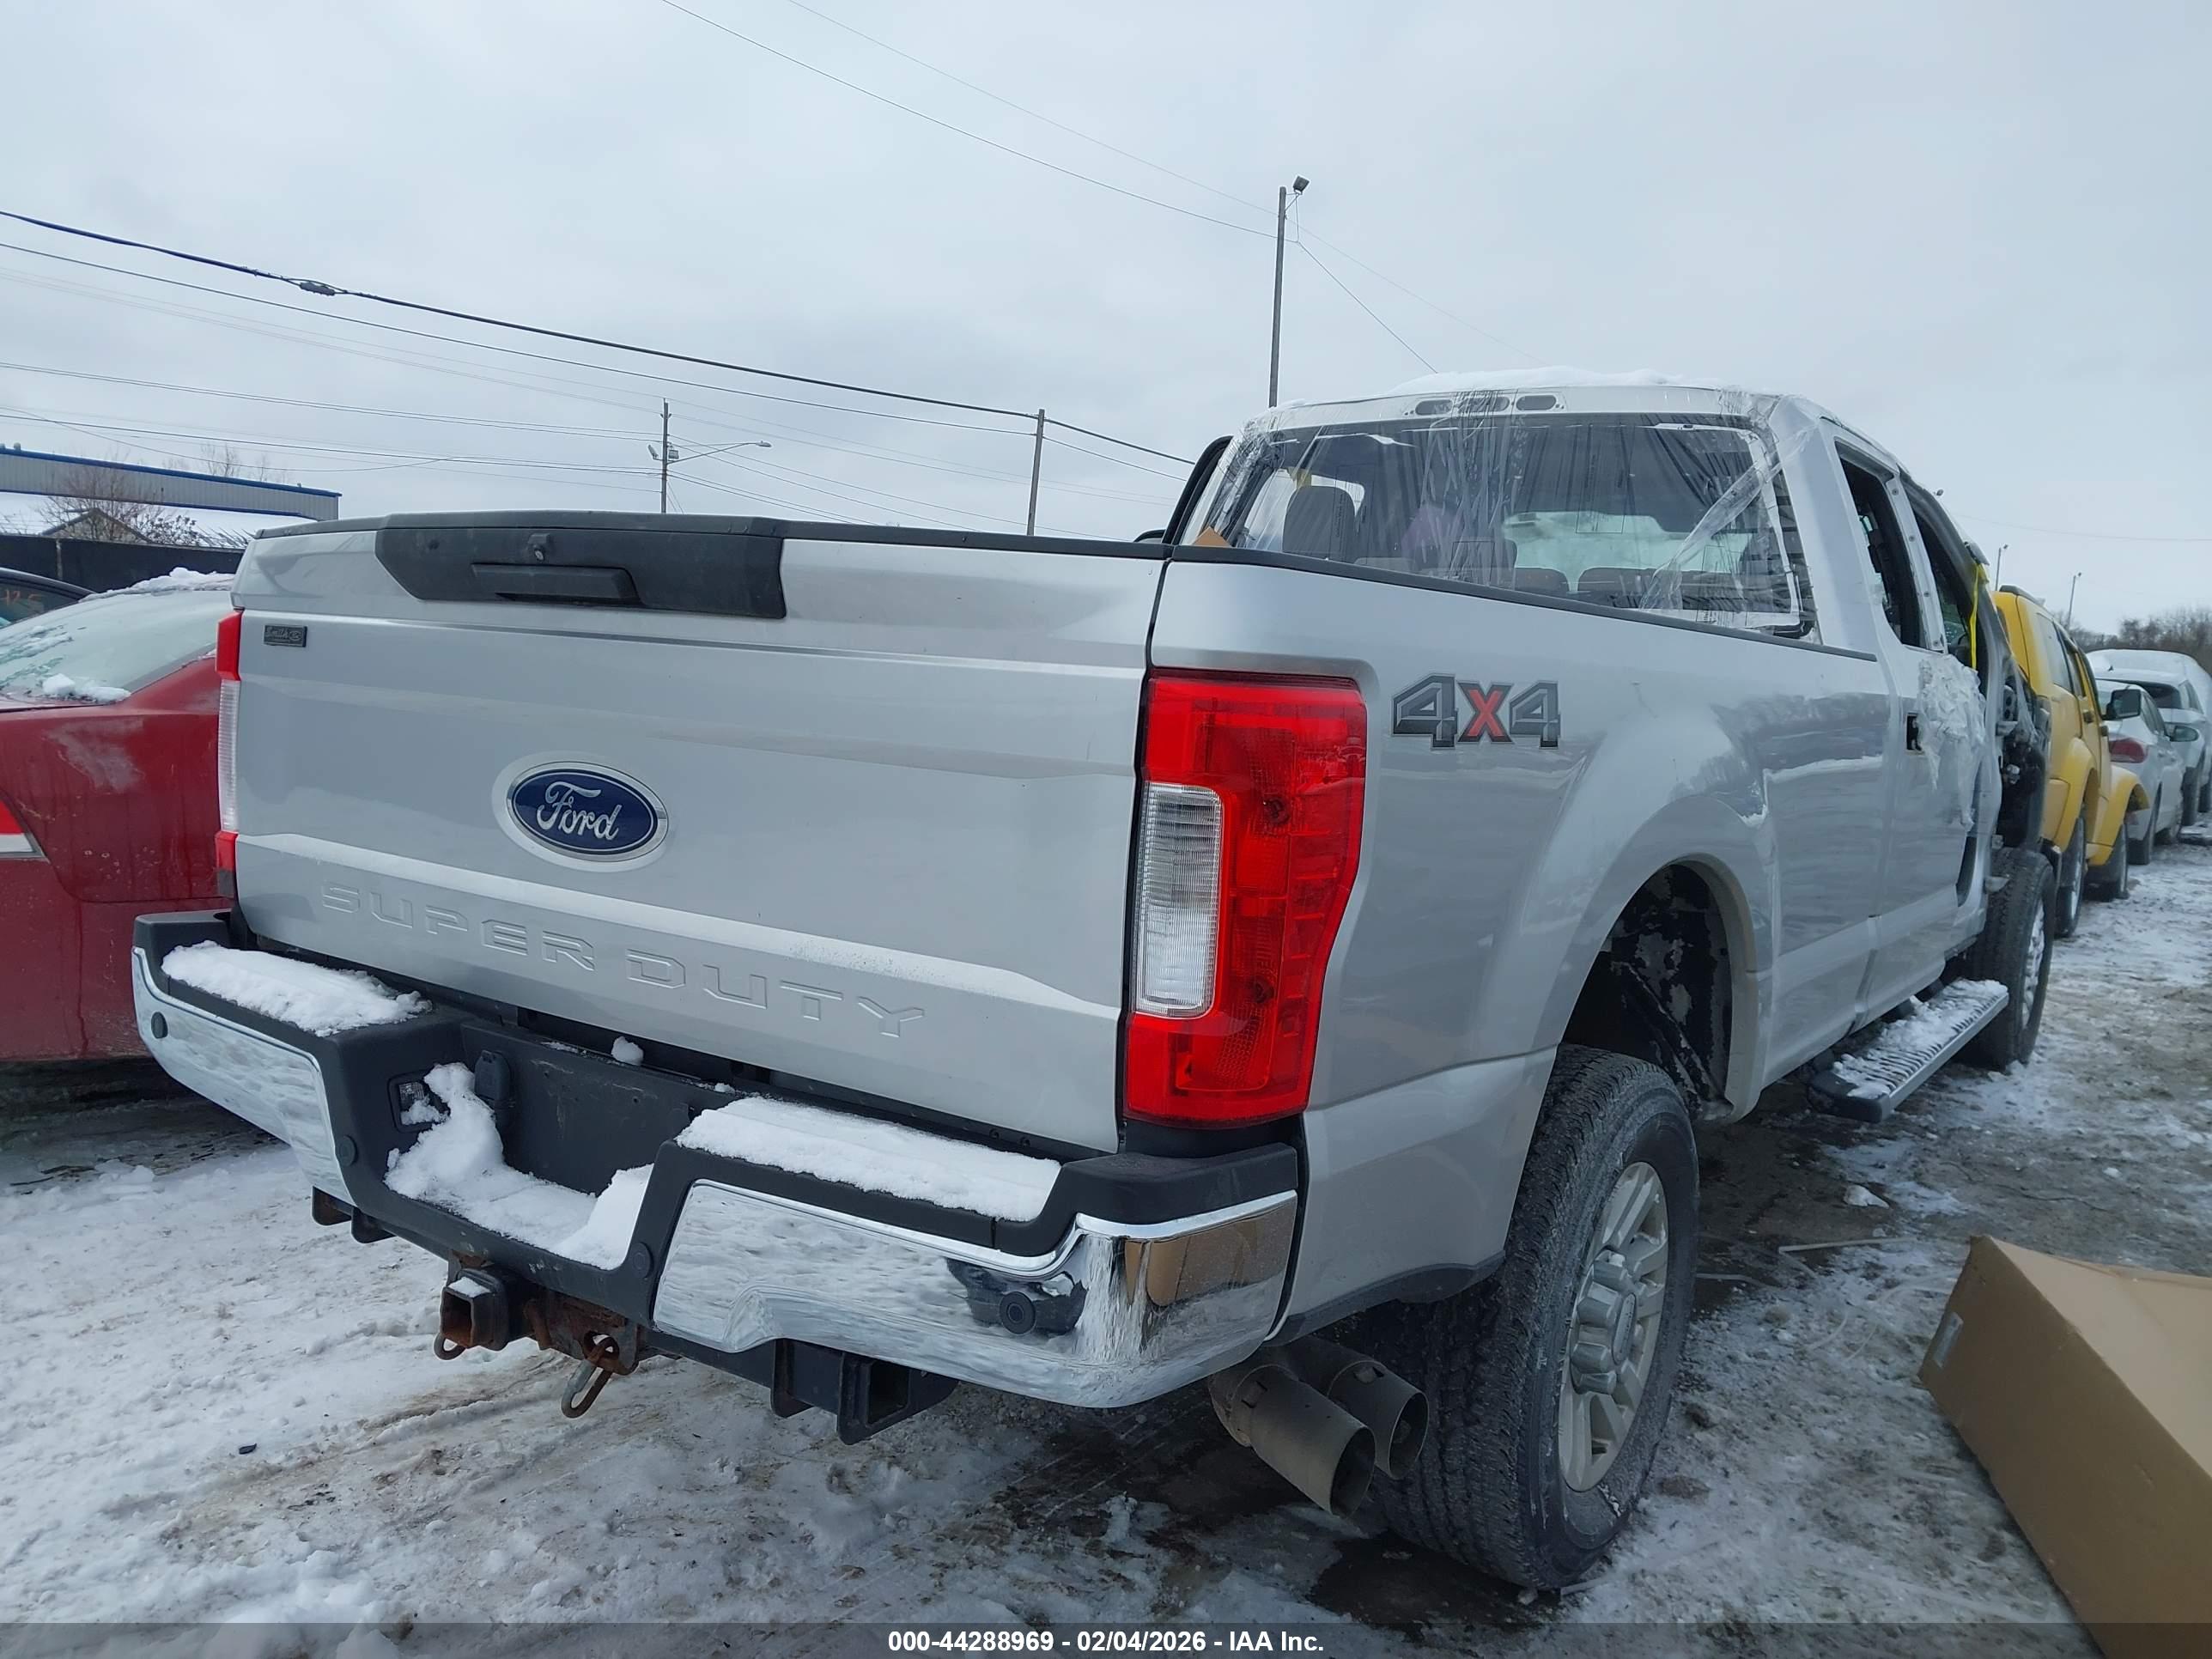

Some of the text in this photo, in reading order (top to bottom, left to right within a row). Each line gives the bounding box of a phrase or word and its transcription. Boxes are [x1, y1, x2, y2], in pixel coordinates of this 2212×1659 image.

[537, 781, 622, 841] Ford
[322, 879, 925, 1037] SUPER DUTY
